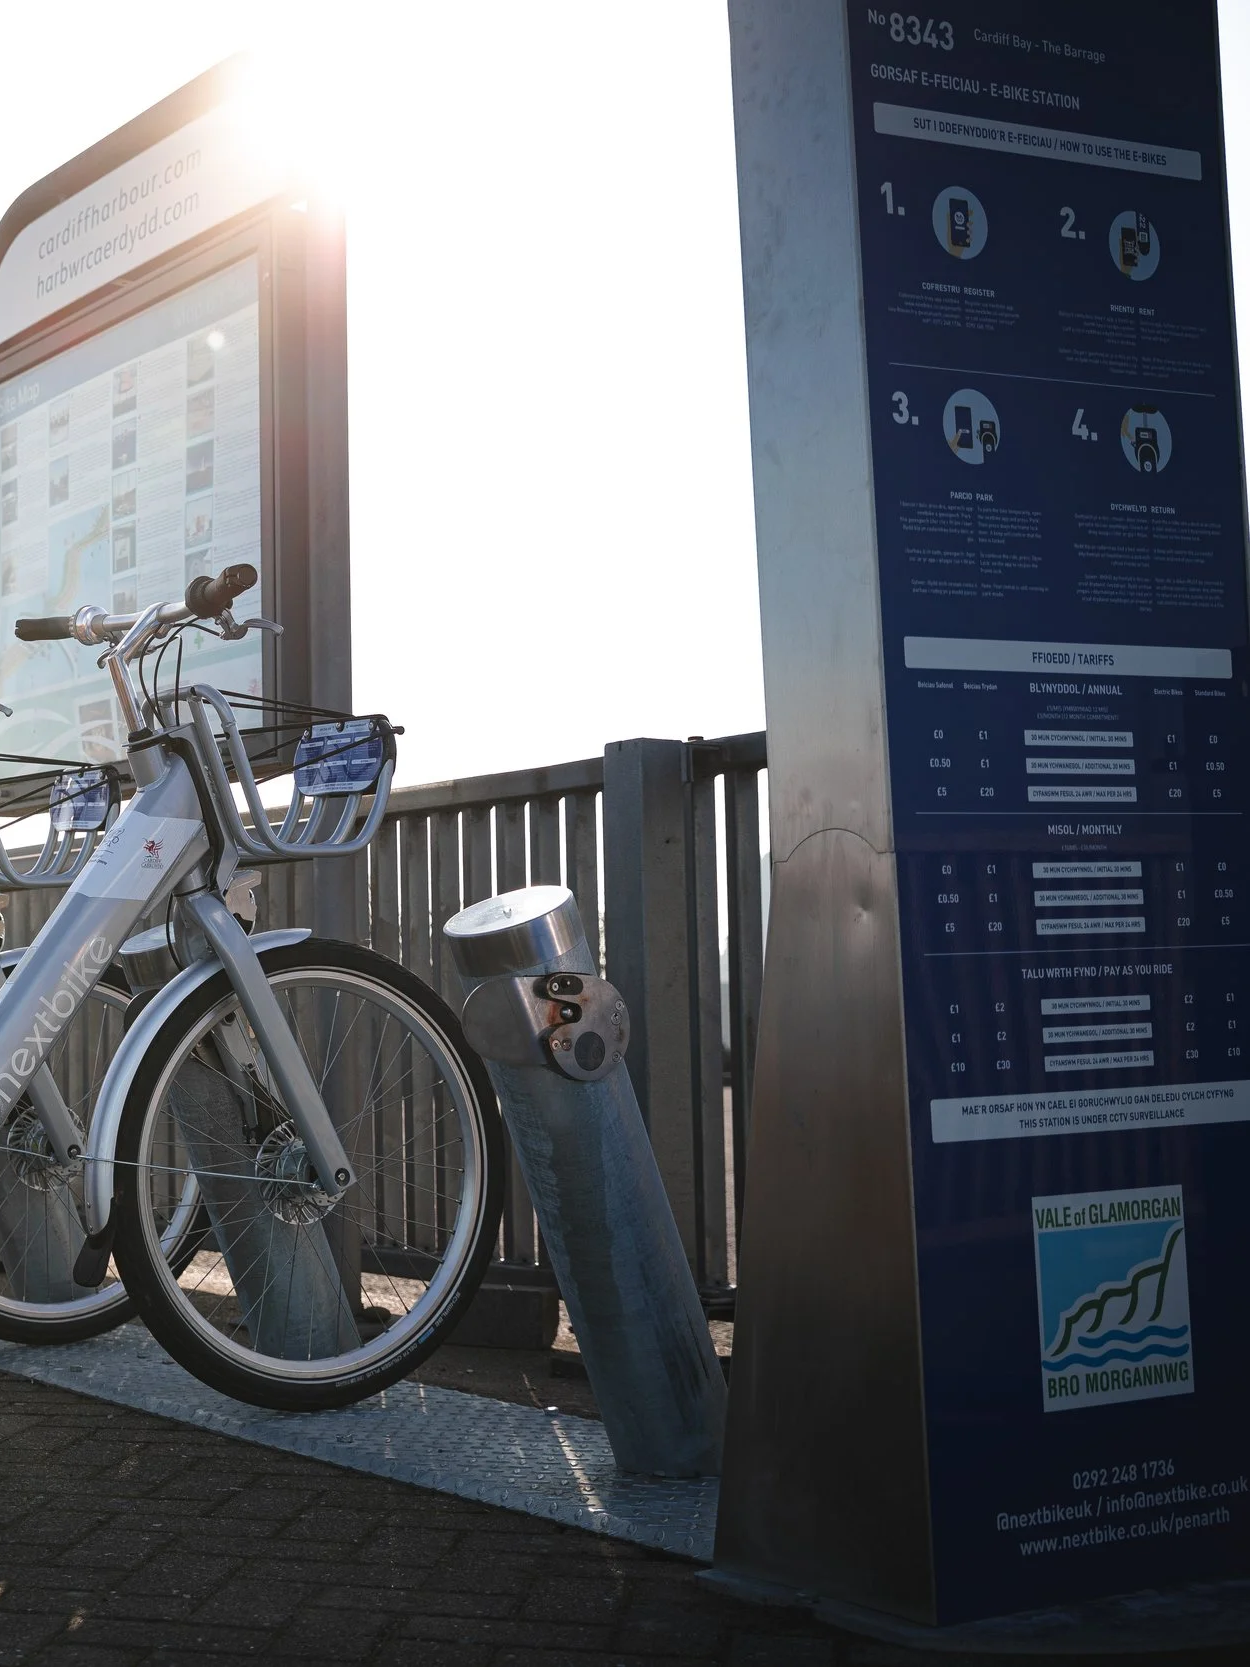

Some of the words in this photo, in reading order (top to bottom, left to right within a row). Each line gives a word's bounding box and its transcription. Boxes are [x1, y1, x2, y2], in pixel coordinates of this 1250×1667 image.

[868, 8, 886, 26] No
[889, 12, 955, 51] 8343
[973, 28, 1009, 48] Cardiff
[1012, 34, 1031, 52] Bay
[1041, 39, 1061, 57] The
[1063, 43, 1105, 64] Barrage
[870, 62, 918, 86] GORSAF
[920, 70, 980, 96] E-FEICIAU
[990, 80, 1030, 103] E-BIKE
[1031, 86, 1080, 110] STATION
[913, 116, 931, 134] SUT
[933, 119, 937, 135] I
[938, 120, 1006, 145] DDEFNYDDIO'R
[1007, 130, 1052, 151] E-FEICIAU
[1059, 137, 1080, 155] HOW
[1081, 140, 1093, 157] TO
[1094, 142, 1112, 160] USE
[1113, 145, 1131, 162] THE
[1132, 148, 1166, 167] E-BIKES
[38, 146, 202, 260] cardiffharbour.com
[879, 181, 906, 216] 1.
[1059, 206, 1086, 240] 2.
[36, 190, 200, 299] harbwrcaerdydd.com
[921, 282, 960, 294] COFRESTRU
[963, 286, 995, 298] REGISTER
[1109, 304, 1135, 315] RHENTU
[1137, 306, 1155, 317] RENT
[18, 382, 40, 405] Map
[891, 390, 919, 425] 3.
[1071, 408, 1098, 441] 4.
[949, 491, 973, 501] PARCIO
[975, 492, 993, 502] PARK
[1110, 503, 1146, 514] DYCHWELYD
[1151, 504, 1175, 515] RETURN
[1031, 652, 1070, 665] FFIOEDD
[1077, 653, 1114, 666] TARIFFS
[1029, 683, 1080, 695] BLYNYDDOL
[1087, 684, 1122, 696] ANNUAL
[1153, 688, 1170, 696] Electric
[1170, 688, 1183, 696] Bikes
[933, 730, 944, 740] £0
[978, 730, 988, 740] £1
[1167, 734, 1176, 744] £1
[1209, 734, 1218, 744] £0
[930, 758, 951, 768] £0.50
[980, 758, 990, 768] £1
[1169, 762, 1178, 771] £1
[1206, 762, 1225, 772] £0.50
[937, 787, 947, 797] £5
[980, 787, 994, 797] £20
[1168, 788, 1182, 798] £20
[1212, 788, 1222, 798] £5
[1047, 824, 1074, 835] MISOL
[1081, 824, 1122, 835] MONTHLY
[942, 865, 952, 875] £0
[986, 864, 996, 874] £1
[1176, 862, 1184, 872] £1
[1218, 862, 1226, 872] £0
[938, 893, 959, 904] £0.50
[989, 893, 998, 902] £1
[1178, 890, 1186, 900] £1
[1214, 890, 1234, 899] £0.50
[1178, 918, 1190, 926] £20
[1222, 916, 1230, 926] £5
[946, 922, 955, 933] £5
[988, 922, 1002, 932] £20
[1021, 968, 1044, 979] TALU
[1045, 967, 1072, 979] WRTH
[1073, 966, 1096, 978] FYND
[1103, 965, 1120, 977] PAY
[1121, 965, 1133, 976] AS
[1133, 964, 1151, 976] YOU
[1152, 964, 1173, 975] RIDE
[1184, 994, 1194, 1004] £2
[1226, 993, 1234, 1002] £1
[950, 1004, 960, 1014] £1
[995, 1002, 1005, 1012] £2
[1186, 1022, 1196, 1032] £2
[1228, 1020, 1236, 1030] £1
[952, 1034, 961, 1044] £1
[997, 1032, 1006, 1042] £2
[1186, 1050, 1199, 1059] £30
[1228, 1048, 1240, 1057] £10
[951, 1062, 966, 1072] £10
[996, 1060, 1011, 1070] £30
[961, 1103, 987, 1116] MAE'R
[988, 1102, 1014, 1114] ORSAF
[1016, 1101, 1033, 1113] HON
[1034, 1100, 1045, 1112] YN
[1047, 1099, 1067, 1111] CAEL
[1068, 1098, 1076, 1110] EI
[1077, 1095, 1132, 1109] GORUCHWYLIO
[1133, 1094, 1149, 1106] GAN
[1150, 1092, 1180, 1105] DELEDU
[1181, 1090, 1205, 1103] CYLCH
[1205, 1089, 1234, 1101] CYFYNG
[1018, 1118, 1037, 1129] THIS
[1038, 1116, 1070, 1128] STATION
[1072, 1115, 1080, 1126] IS
[1080, 1113, 1107, 1125] UNDER
[1108, 1112, 1128, 1124] CCTV
[1129, 1108, 1185, 1122] SURVEILLANCE
[1035, 1206, 1072, 1230] VALE
[1074, 1208, 1086, 1226] of
[1088, 1196, 1181, 1225] GLAMORGAN
[1048, 1374, 1080, 1400] BRO
[1086, 1361, 1189, 1394] MORGANNWG
[1072, 1468, 1108, 1490] 0292
[1112, 1464, 1138, 1484] 248
[1142, 1458, 1175, 1480] 1736
[996, 1500, 1092, 1532] @nextbikeuk
[1106, 1475, 1249, 1514] info@nextbike.co.uk
[1020, 1506, 1230, 1556] www.nextbike.co.uk/penarth
